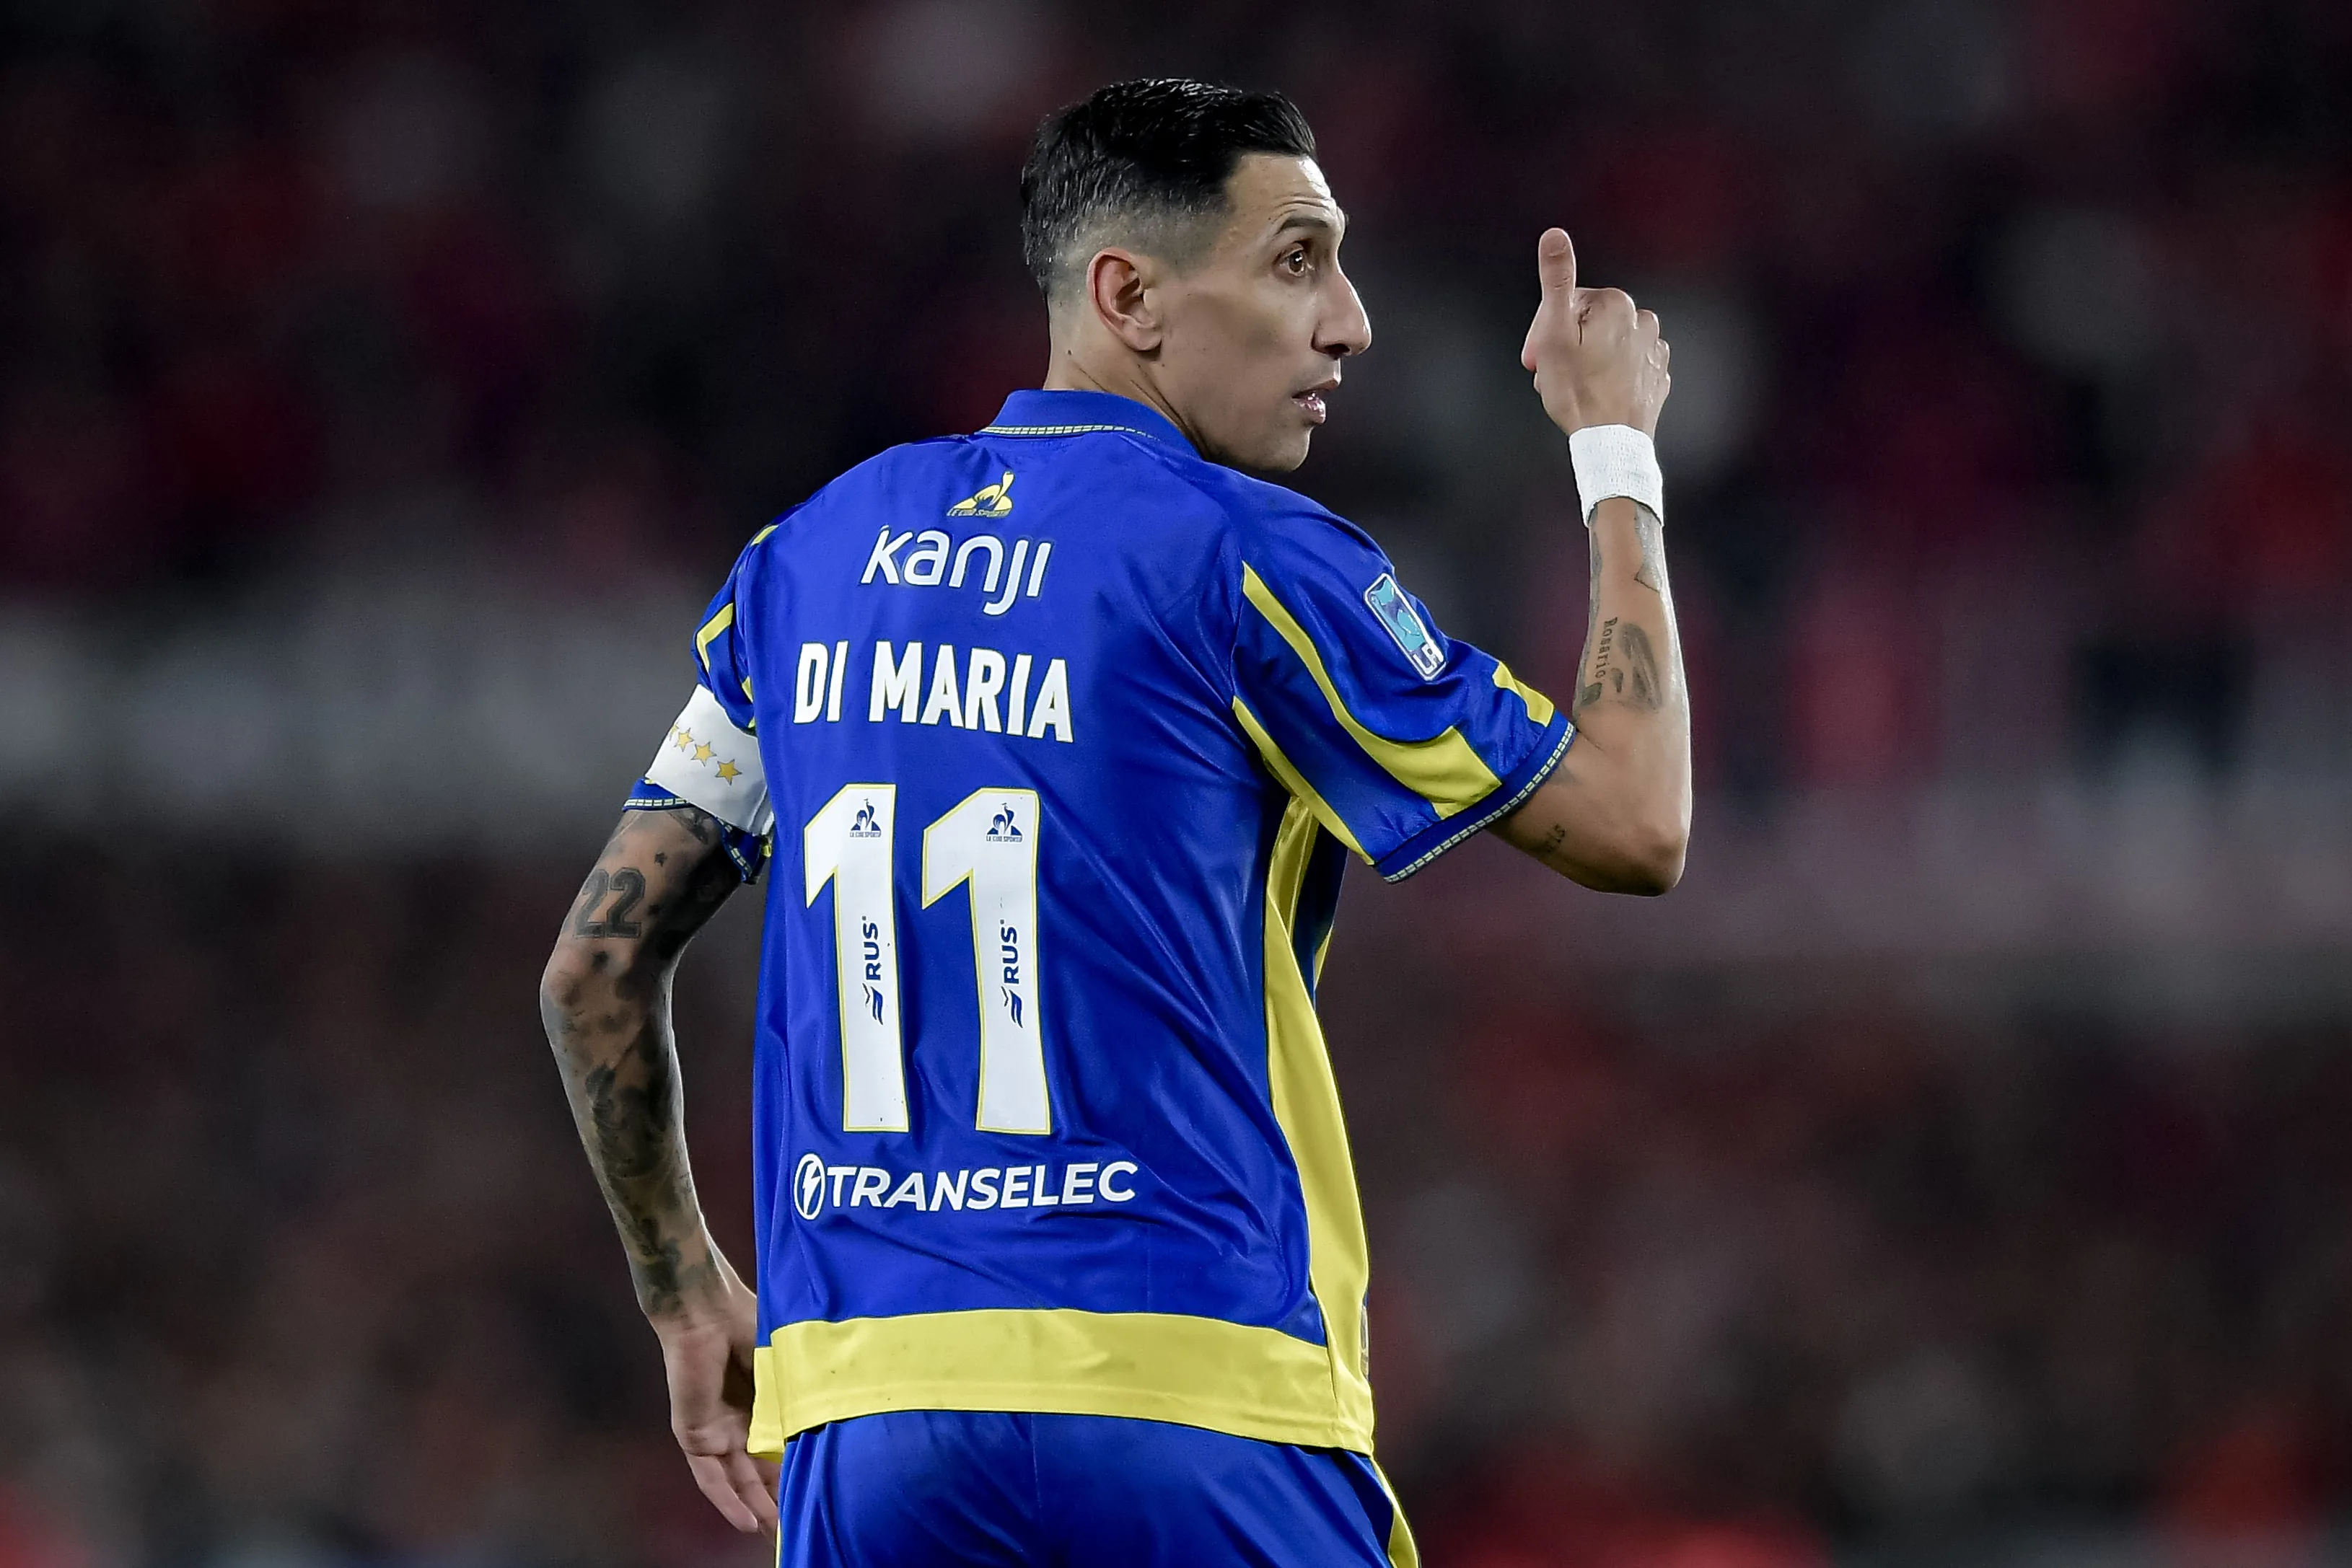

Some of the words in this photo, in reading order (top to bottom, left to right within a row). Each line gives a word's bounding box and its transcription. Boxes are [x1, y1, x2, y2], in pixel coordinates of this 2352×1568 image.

[861, 525, 1051, 615] kanji
[1594, 617, 1618, 679] Rosario
[794, 640, 849, 723] DI
[868, 640, 1074, 743] MARIA
[575, 867, 646, 938] 22
[804, 783, 1051, 1135] 11
[862, 922, 882, 981] RUS
[1000, 926, 1019, 985] RUS
[827, 1160, 1138, 1212] TRANSELEC
